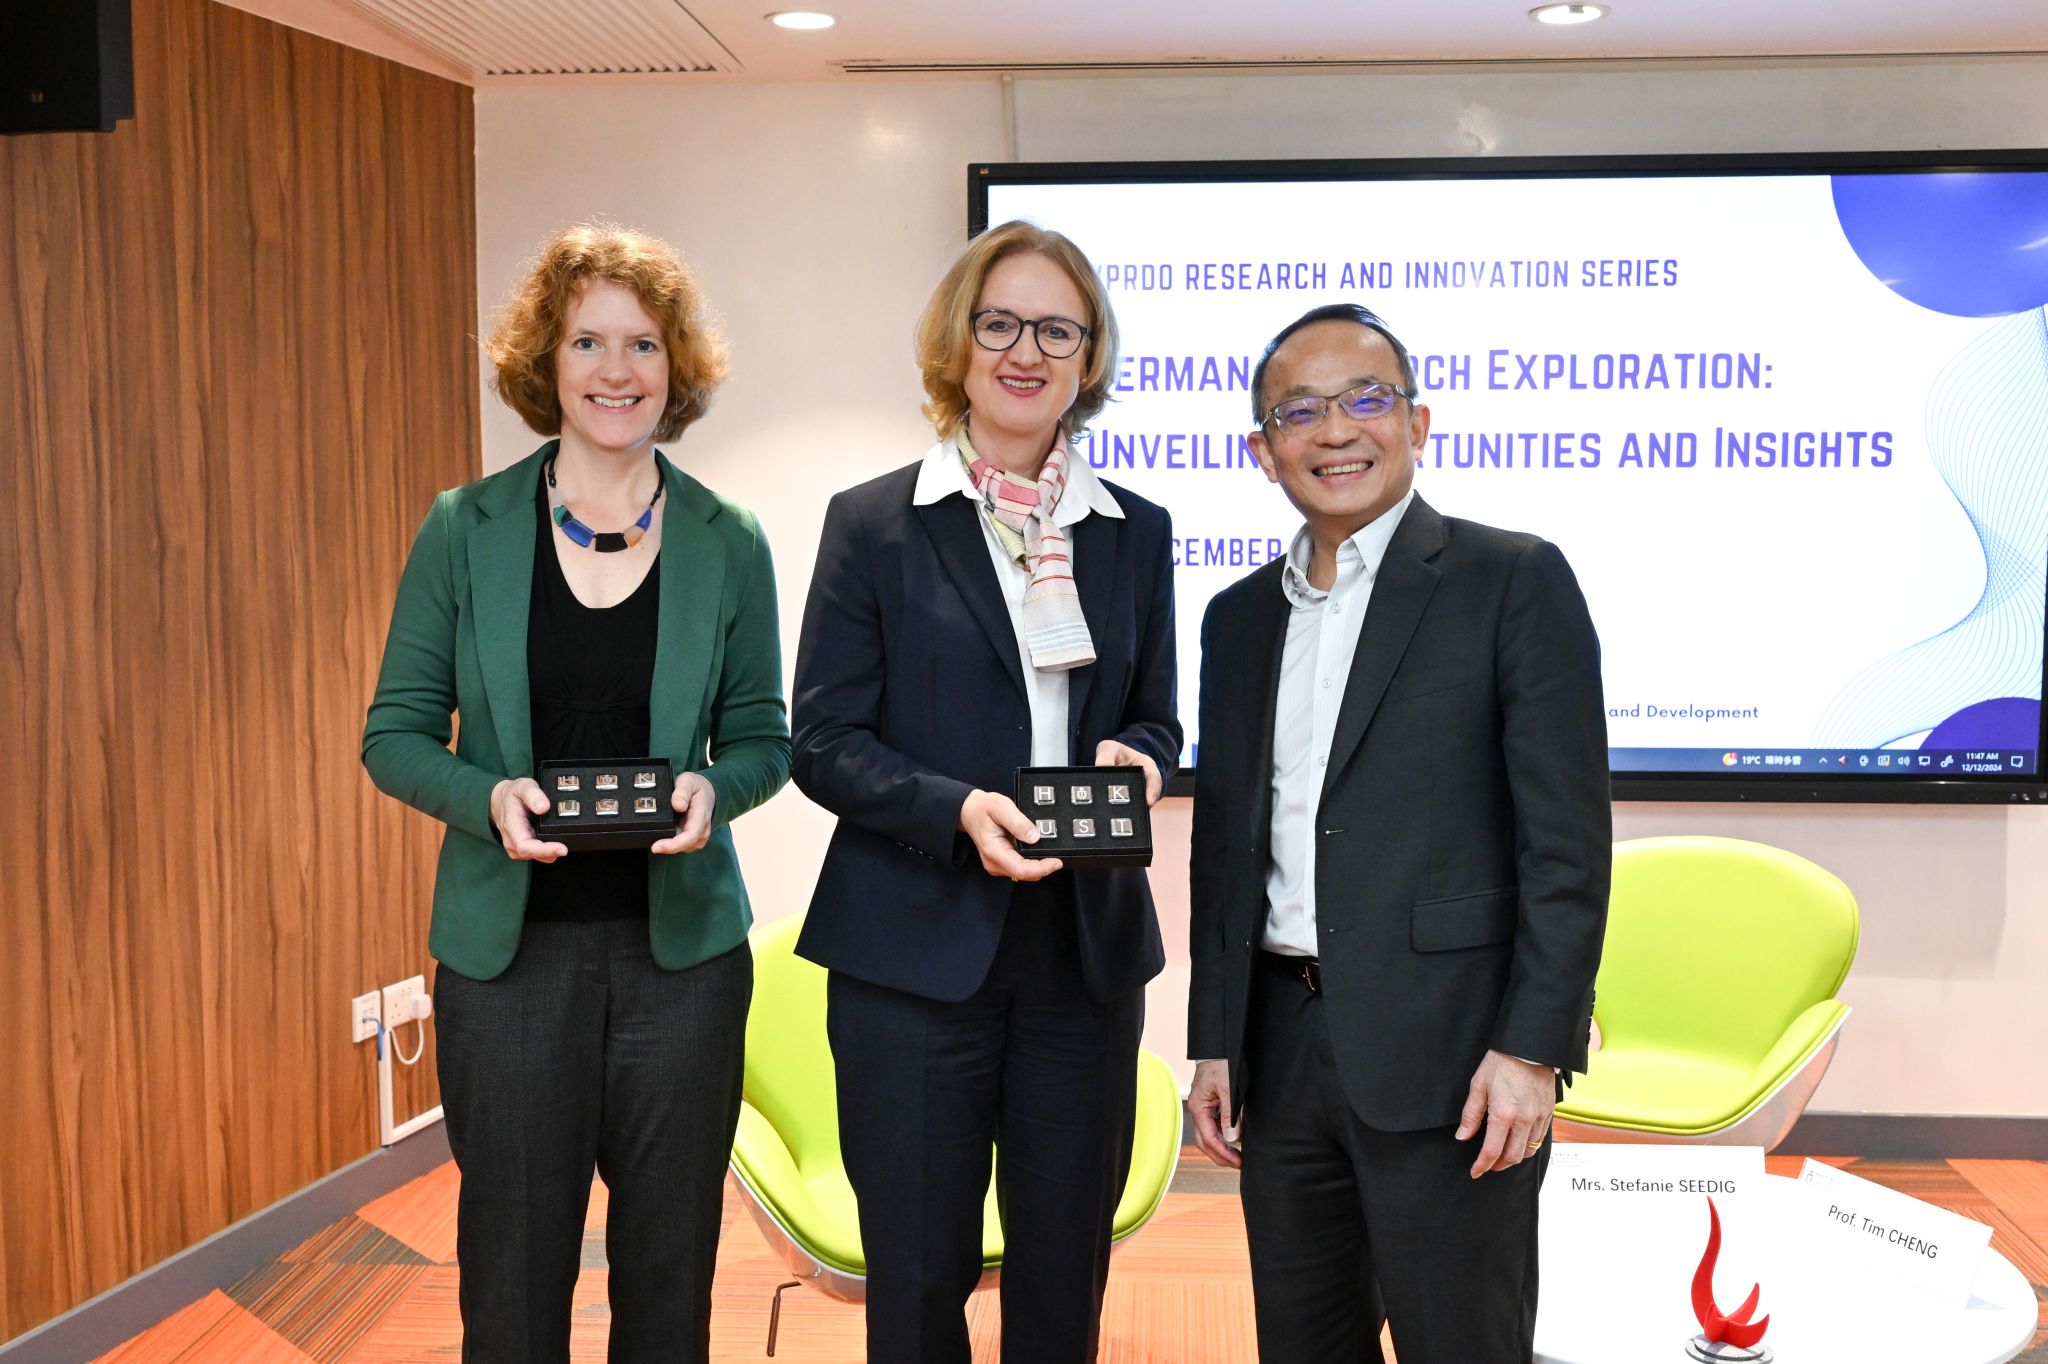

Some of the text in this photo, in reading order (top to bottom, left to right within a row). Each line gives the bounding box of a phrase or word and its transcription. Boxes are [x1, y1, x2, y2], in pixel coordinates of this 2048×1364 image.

[1099, 259, 1678, 290] PRDO RESEARCH AND INNOVATION SERIES
[1115, 356, 1249, 392] ERMAN
[1488, 349, 1773, 390] EXPLORATION:
[1088, 427, 1893, 469] UNVEILIN TUNITIES AND INSIGHTS
[1608, 704, 1759, 723] and Development
[1961, 763, 2003, 772] 12/12/2024
[1966, 752, 1999, 760] 11:47 AM
[1572, 1178, 1736, 1193] Mrs. Stefanie SEEDIG
[1828, 1205, 1939, 1259] Prof. Tim CHENG
